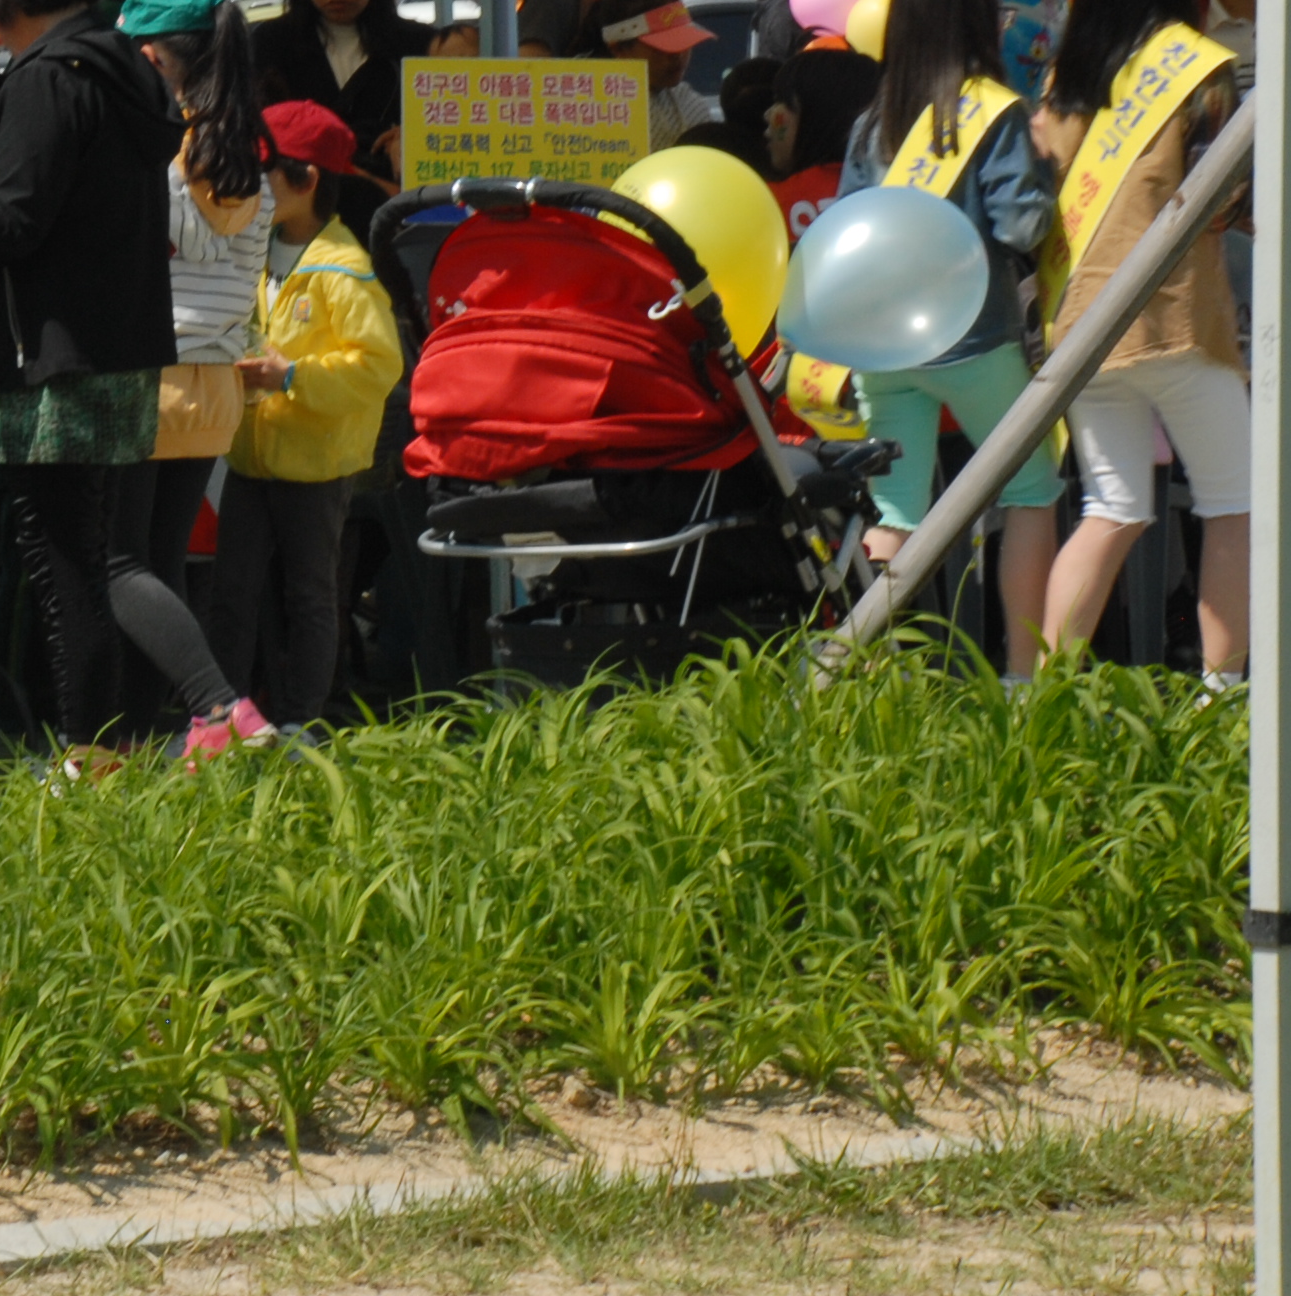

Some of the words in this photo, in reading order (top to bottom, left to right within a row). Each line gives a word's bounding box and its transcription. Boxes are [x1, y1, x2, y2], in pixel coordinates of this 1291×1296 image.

[414, 72, 469, 97] 친구의
[603, 74, 638, 97] 하는
[424, 102, 460, 125] 것은
[470, 103, 489, 124] 또
[499, 103, 535, 125] 다른
[544, 103, 631, 125] 폭력입니다
[426, 133, 491, 154] 학교폭력
[501, 133, 534, 153] 신고
[415, 160, 481, 180] 전화신고
